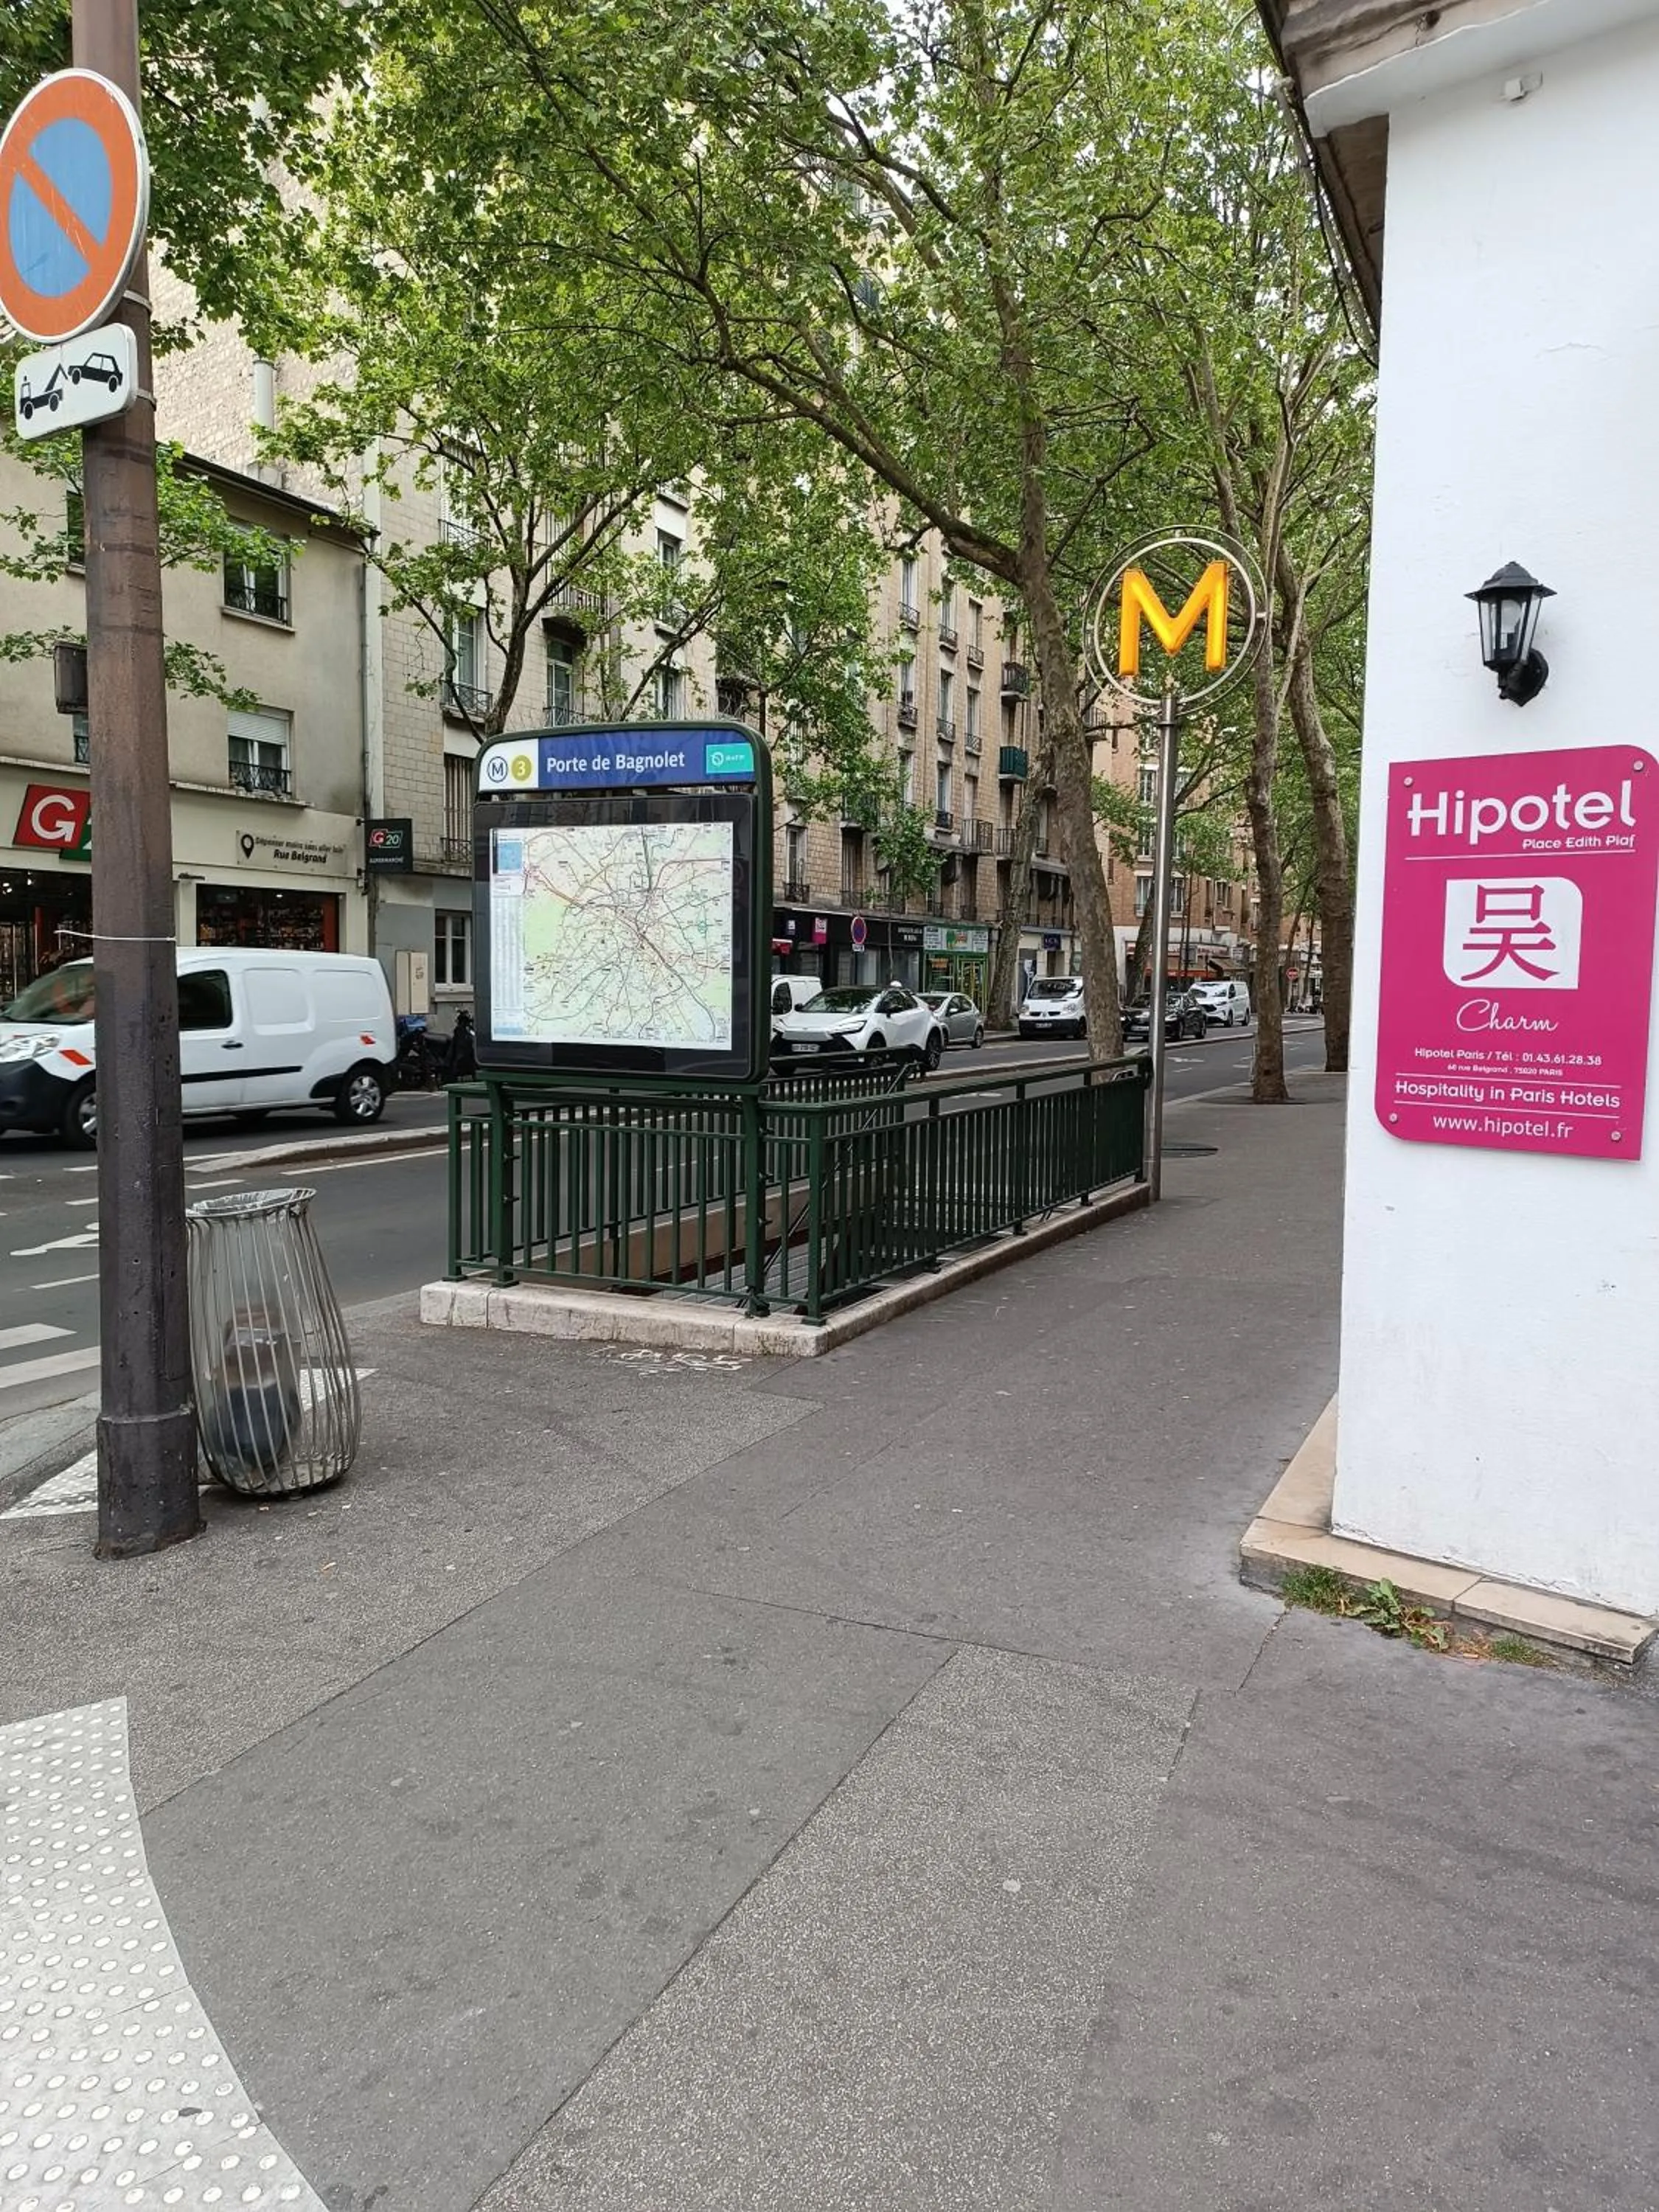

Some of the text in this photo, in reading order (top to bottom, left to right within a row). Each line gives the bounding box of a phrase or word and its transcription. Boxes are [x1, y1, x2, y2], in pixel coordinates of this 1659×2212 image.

[1119, 558, 1230, 677] M
[492, 751, 685, 778] M 3 Porte de Bagnolet
[1407, 779, 1637, 846] Hipotel
[372, 831, 400, 846] G20
[1522, 834, 1635, 850] Place Edith Piaf
[274, 849, 327, 864] Rue Belgrand
[1455, 999, 1559, 1032] Charm
[1414, 1048, 1455, 1059] Hipotel
[1456, 1049, 1484, 1060] Paris
[1472, 1064, 1508, 1074] Belgrand
[1539, 1068, 1564, 1077] PARIS
[1394, 1080, 1621, 1108] Hospitality in Paris Hotels
[1433, 1114, 1573, 1138] www.hipotel.fr
